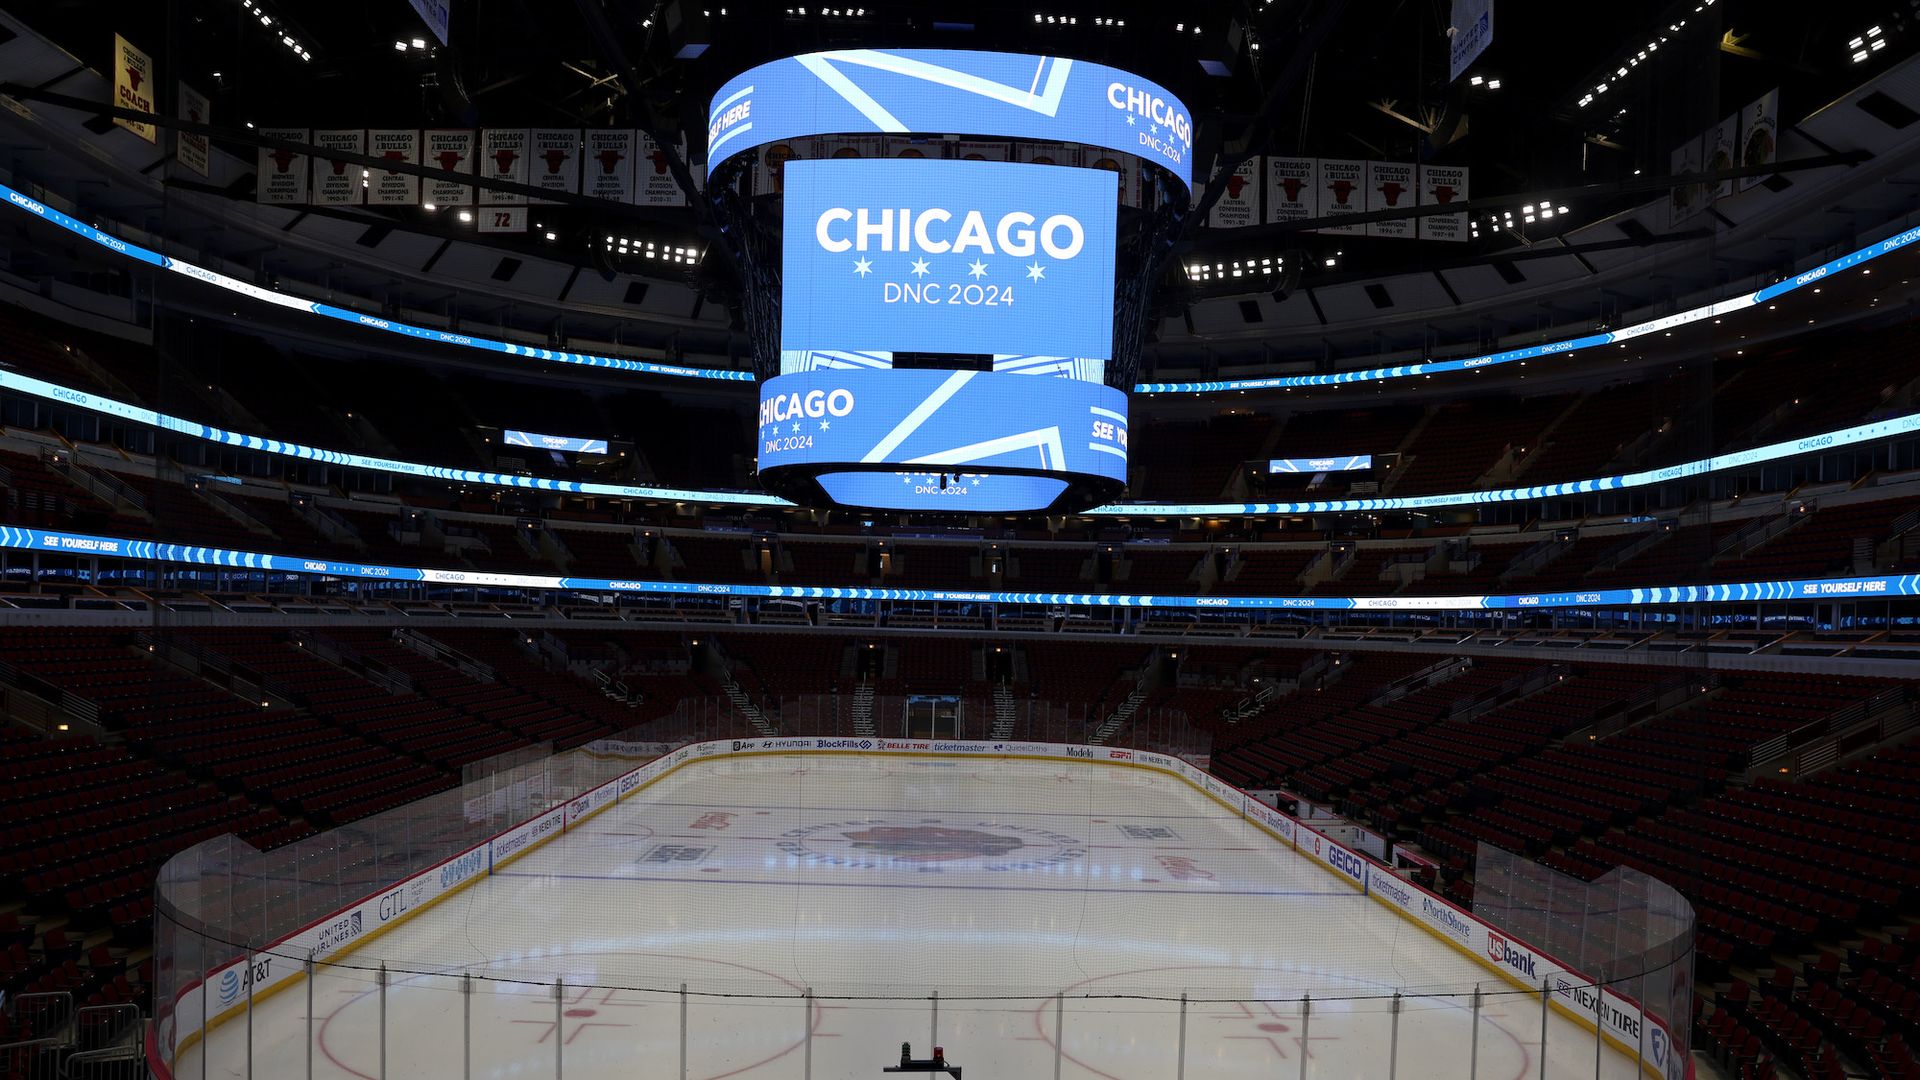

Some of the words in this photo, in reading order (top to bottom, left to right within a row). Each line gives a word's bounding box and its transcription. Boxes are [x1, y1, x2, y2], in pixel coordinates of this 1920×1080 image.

[120, 85, 150, 113] COACH
[722, 100, 752, 131] HERE
[1107, 82, 1190, 148] CHICAGO
[320, 134, 358, 142] CHICAGO
[375, 134, 412, 142] CHICAGO
[1140, 132, 1161, 152] DNC
[1162, 143, 1181, 164] 2024
[1274, 162, 1310, 170] CHICAGO
[1324, 164, 1360, 172] CHICAGO
[1374, 166, 1410, 174] CHICAGO
[1380, 174, 1405, 182] BULLS
[1427, 170, 1462, 178] CHICAGO
[1432, 178, 1457, 186] BULLS
[10, 192, 44, 215] CHICAGO
[495, 212, 510, 227] 72
[816, 207, 1084, 260] CHICAGO
[96, 232, 110, 244] DNC
[110, 238, 126, 252] 2024
[1884, 237, 1901, 250] DNC
[186, 266, 217, 282] CHICAGO
[1796, 267, 1827, 285] CHICAGO
[884, 282, 940, 304] DNC
[947, 284, 1014, 306] 2024
[360, 316, 389, 328] CHICAGO
[1626, 323, 1656, 336] CHICAGO
[440, 333, 454, 342] DNC
[455, 336, 471, 344] 2024
[1542, 344, 1556, 354] DNC
[1556, 342, 1573, 351] 2024
[1464, 356, 1492, 368] CHICAGO
[660, 366, 686, 374] YOURSELF
[1240, 380, 1266, 388] YOURSELF
[53, 388, 87, 404] CHICAGO
[760, 388, 854, 428] CHICAGO
[1092, 420, 1114, 440] SEE
[766, 439, 782, 454] DNC
[784, 436, 813, 450] 2024
[1798, 436, 1833, 450] CHICAGO
[1728, 454, 1741, 464] DNC
[1742, 452, 1758, 462] 2024
[374, 461, 401, 470] YOURSELF
[401, 464, 414, 472] HERE
[1658, 467, 1682, 478] CHICAGO
[623, 488, 654, 496] CHICAGO
[915, 485, 938, 494] DNC
[941, 486, 968, 496] 2024
[1424, 497, 1448, 505] YOURSELF
[44, 536, 58, 546] SEE
[61, 538, 100, 550] YOURSELF
[100, 541, 118, 552] HERE
[304, 562, 326, 572] CHICAGO
[361, 567, 374, 576] DNC
[374, 568, 389, 576] 2024
[436, 572, 465, 580] CHICAGO
[610, 582, 641, 590] CHICAGO
[713, 585, 730, 593] 2024
[1803, 584, 1818, 594] SEE
[1820, 582, 1862, 593] YOURSELF
[1863, 581, 1886, 592] HERE
[1196, 598, 1228, 606] CHICAGO
[1518, 596, 1539, 605] CHICAGO
[1576, 594, 1588, 602] DNC
[1588, 594, 1600, 602] 2024
[775, 740, 812, 748] HYUNDAI
[816, 740, 858, 748] BlockFills
[887, 742, 910, 750] BELLE
[934, 743, 986, 752] ticketmaster
[1066, 746, 1094, 758] Modelo
[1110, 751, 1132, 760] ESPN
[620, 772, 640, 792] GEICO
[496, 832, 528, 858] ticketmaster
[1329, 846, 1361, 880] GEICO
[1372, 872, 1410, 907] ticketmaster
[380, 888, 406, 920] GTL
[1428, 899, 1470, 936] NorthShore
[319, 920, 349, 940] UNITED
[311, 932, 349, 956] AIRLINES
[242, 958, 272, 990] AT&T
[1574, 988, 1610, 1022] NEXEN
[1612, 1008, 1638, 1039] TIRE
